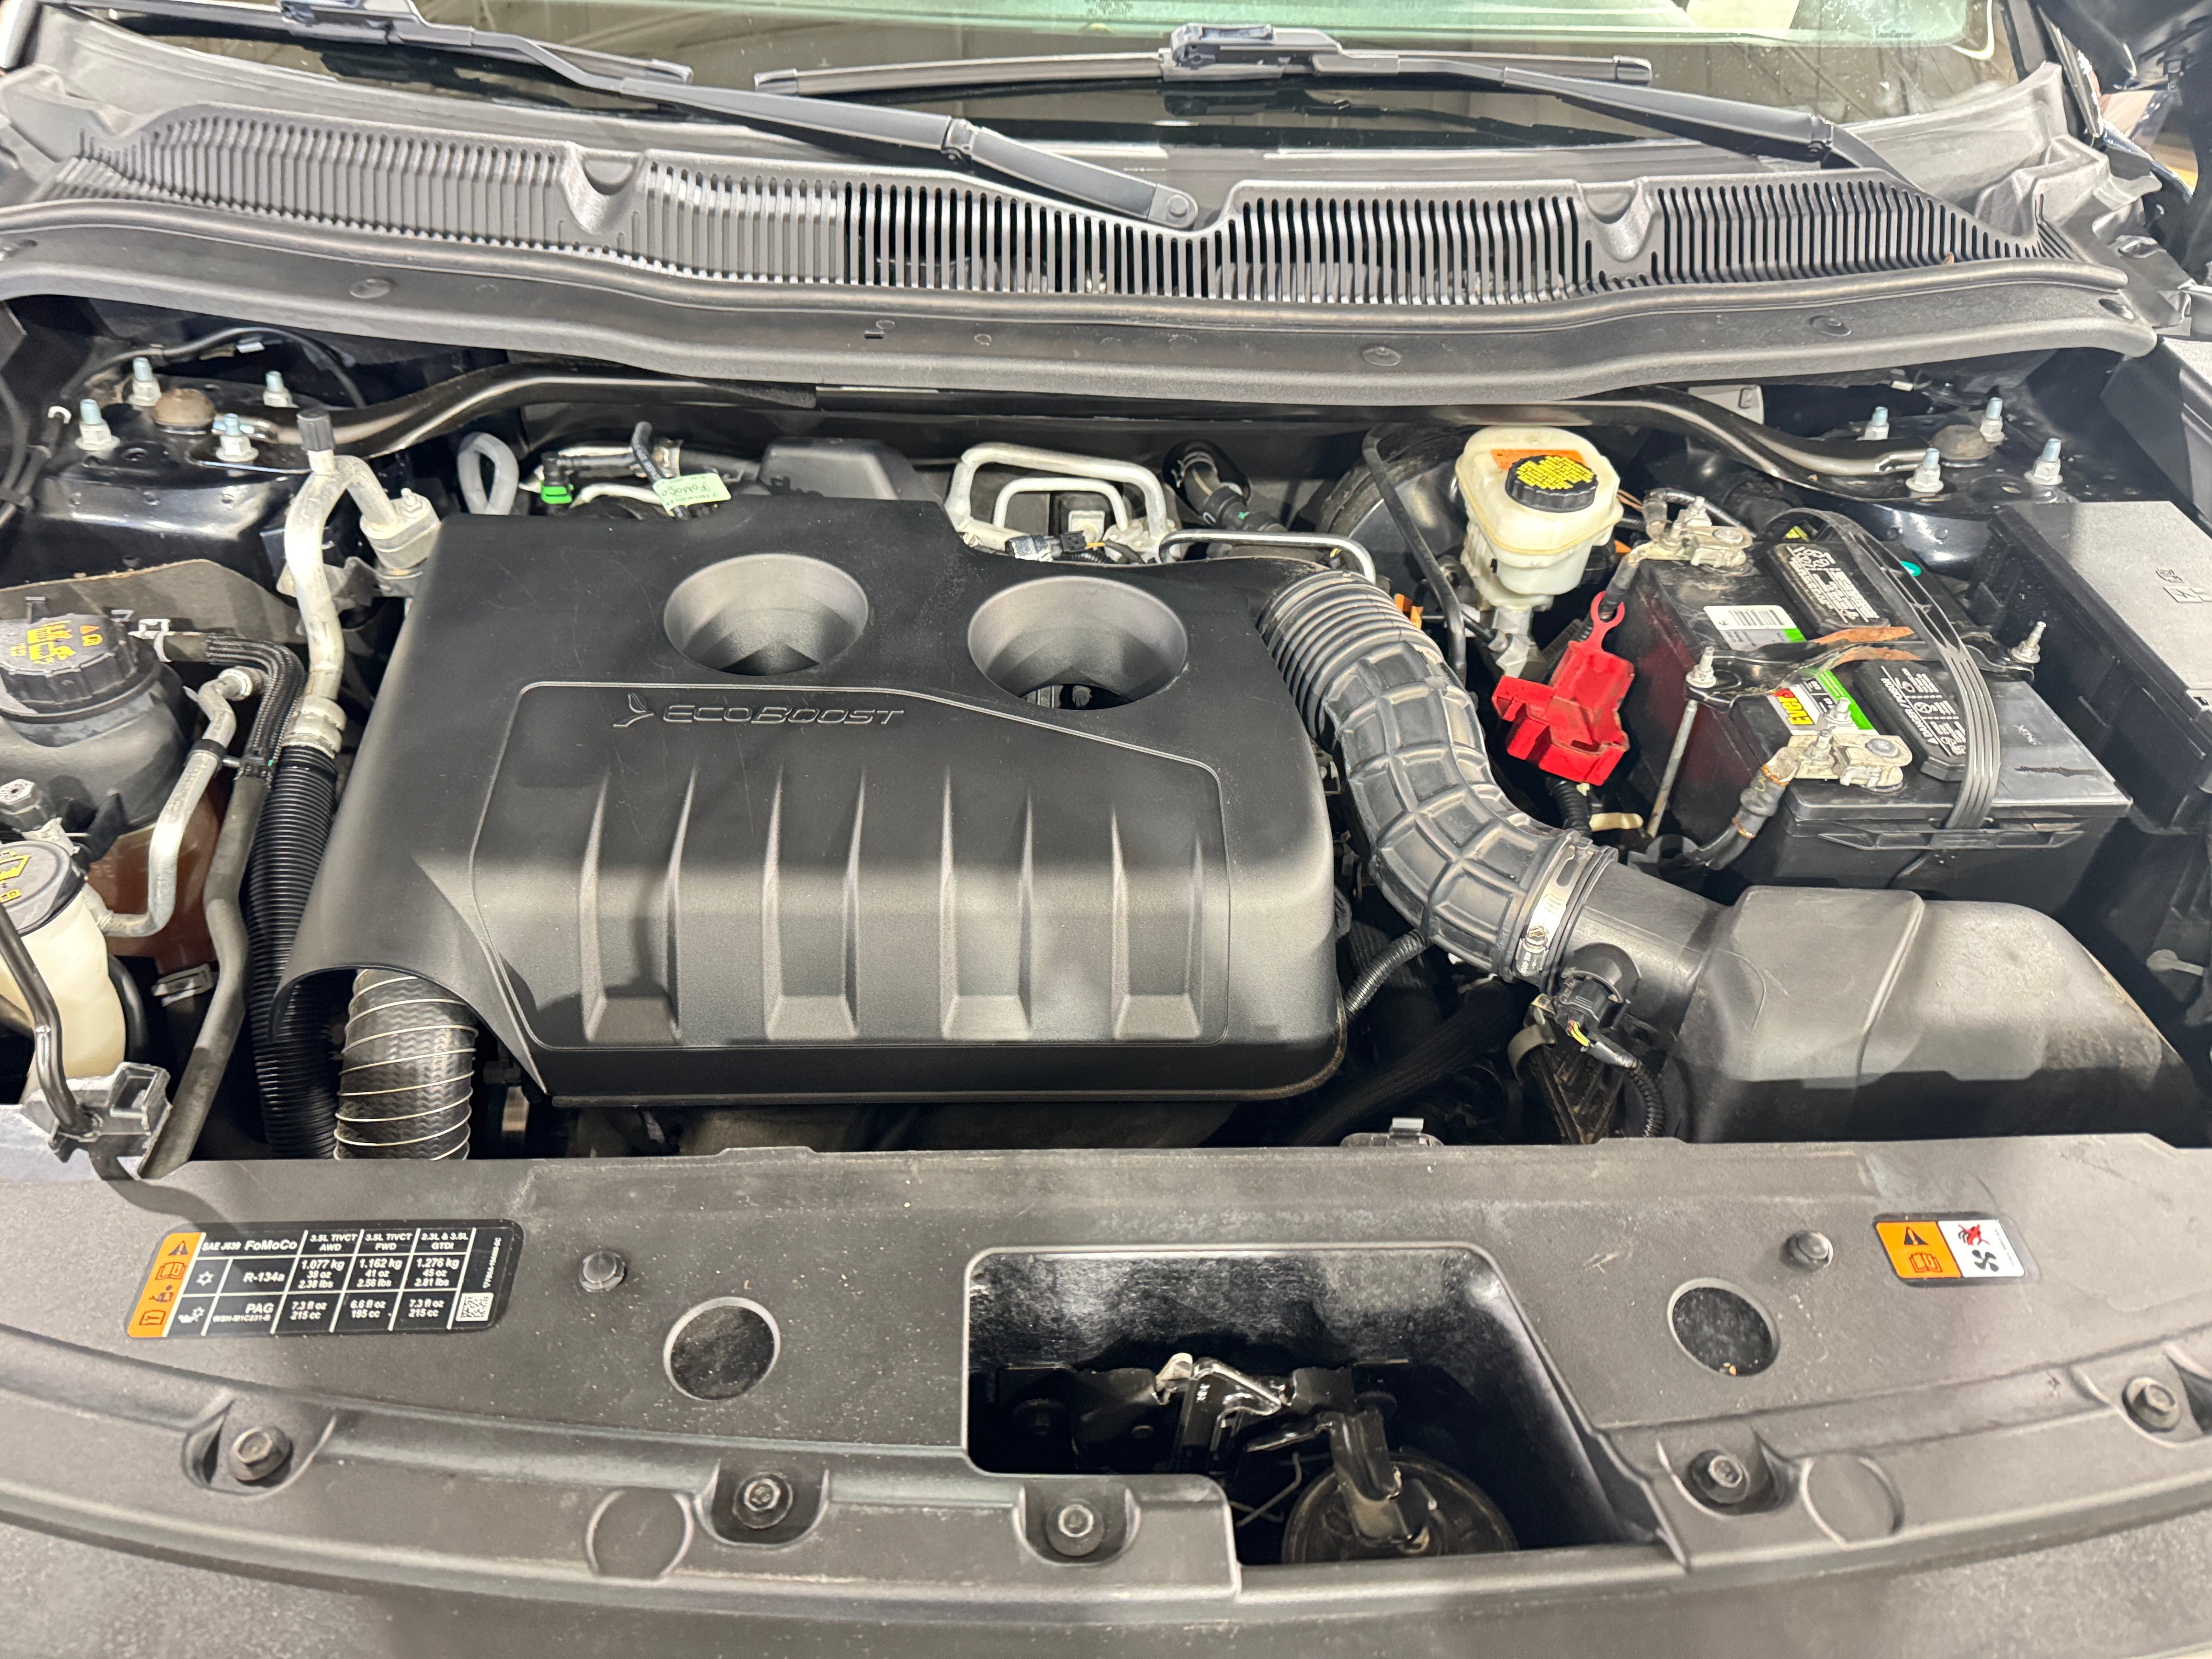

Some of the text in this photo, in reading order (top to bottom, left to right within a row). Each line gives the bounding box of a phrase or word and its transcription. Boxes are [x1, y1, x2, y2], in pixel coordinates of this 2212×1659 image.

[1880, 678, 1906, 704] POISON
[1904, 708, 1934, 737] DANGER
[309, 1234, 329, 1243] 3.5L
[365, 1233, 384, 1242] 3.5L
[421, 1233, 440, 1241] 2.3L
[449, 1232, 469, 1240] 3.5L
[201, 1241, 221, 1251] SAE
[244, 1239, 298, 1251] FoMoCo
[319, 1243, 342, 1251] AWD
[375, 1242, 397, 1251] FWD
[302, 1259, 345, 1272] 1.077 kg
[359, 1258, 403, 1271] 1.162 kg
[416, 1257, 460, 1271] 1.276 kg
[365, 1269, 377, 1278] 41
[422, 1268, 435, 1277] 45
[242, 1272, 285, 1283] R-134a
[297, 1279, 334, 1289] 2.38 lbs
[356, 1278, 392, 1288] 2.56 lbs
[414, 1278, 450, 1287] 2.81 lbs
[245, 1302, 274, 1314] PAG
[291, 1301, 306, 1310] 7.3
[313, 1301, 328, 1310] oz
[350, 1300, 365, 1309] 6.6
[374, 1301, 386, 1309] oz
[409, 1299, 424, 1308] 7.3
[432, 1300, 444, 1308] oz
[290, 1310, 321, 1321] 215 cc
[351, 1309, 381, 1318] 195 cc
[408, 1308, 427, 1318] 215
